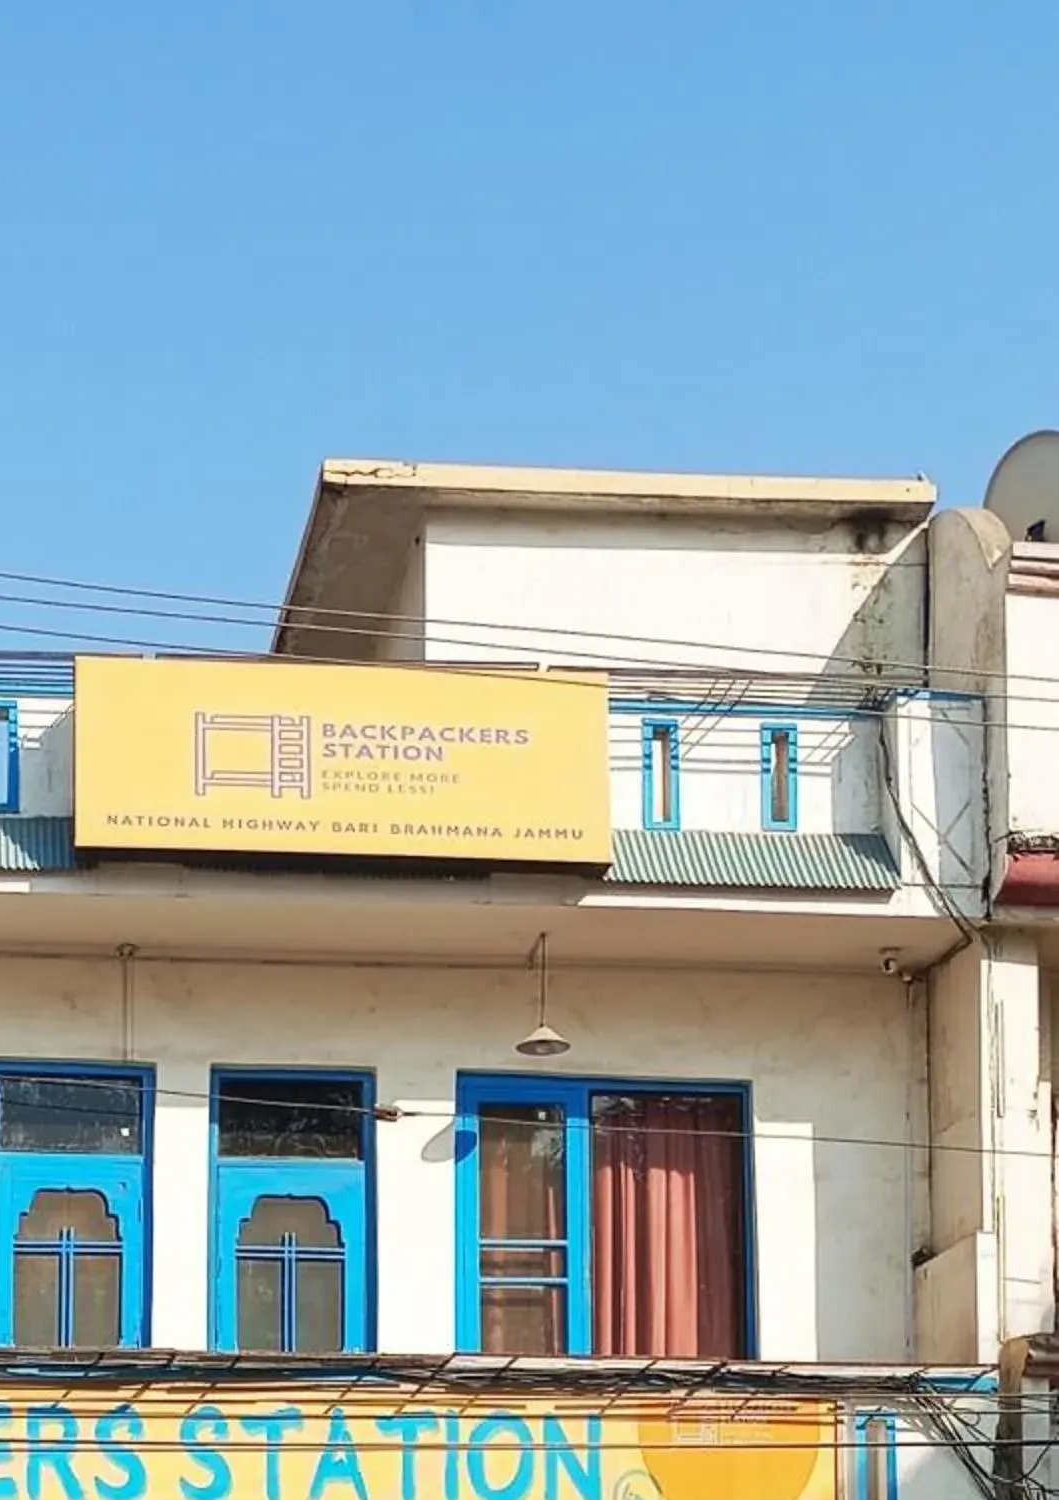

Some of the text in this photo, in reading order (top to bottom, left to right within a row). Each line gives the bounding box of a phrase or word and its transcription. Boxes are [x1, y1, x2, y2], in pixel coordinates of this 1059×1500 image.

[322, 722, 530, 745] BACKPACKERS
[322, 742, 444, 761] STATION
[321, 769, 461, 785] EXPLORE MORE
[321, 780, 436, 795] SPEND LESS!
[106, 813, 584, 841] NATIONAL HIGHWAY BARI BRAHMANA JAMMU
